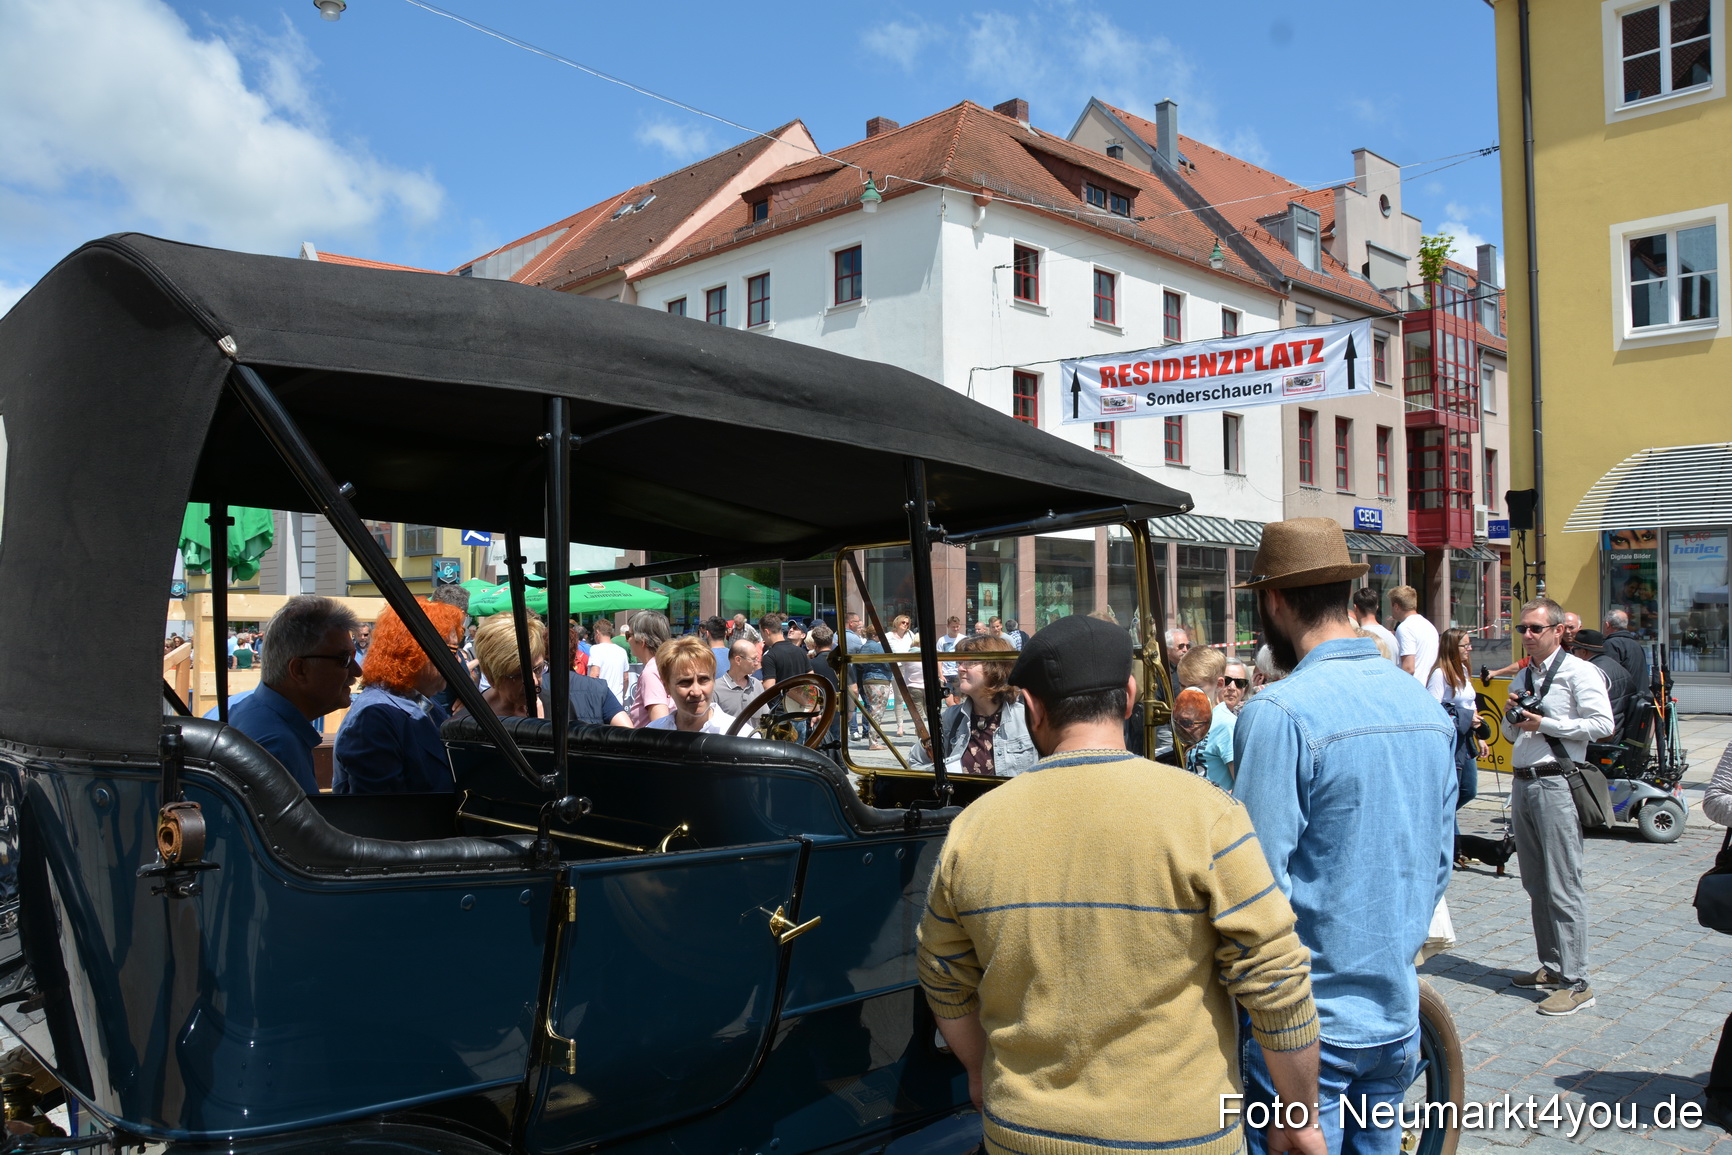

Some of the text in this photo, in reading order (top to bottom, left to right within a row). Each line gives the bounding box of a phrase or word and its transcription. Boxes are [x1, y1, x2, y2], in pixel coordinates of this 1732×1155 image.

[1099, 338, 1324, 389] RESIDENZPLATZ
[1146, 381, 1273, 407] Sonderschauen
[1358, 509, 1382, 523] CECIL
[1673, 544, 1721, 555] hailer
[1610, 553, 1633, 561] Digitale
